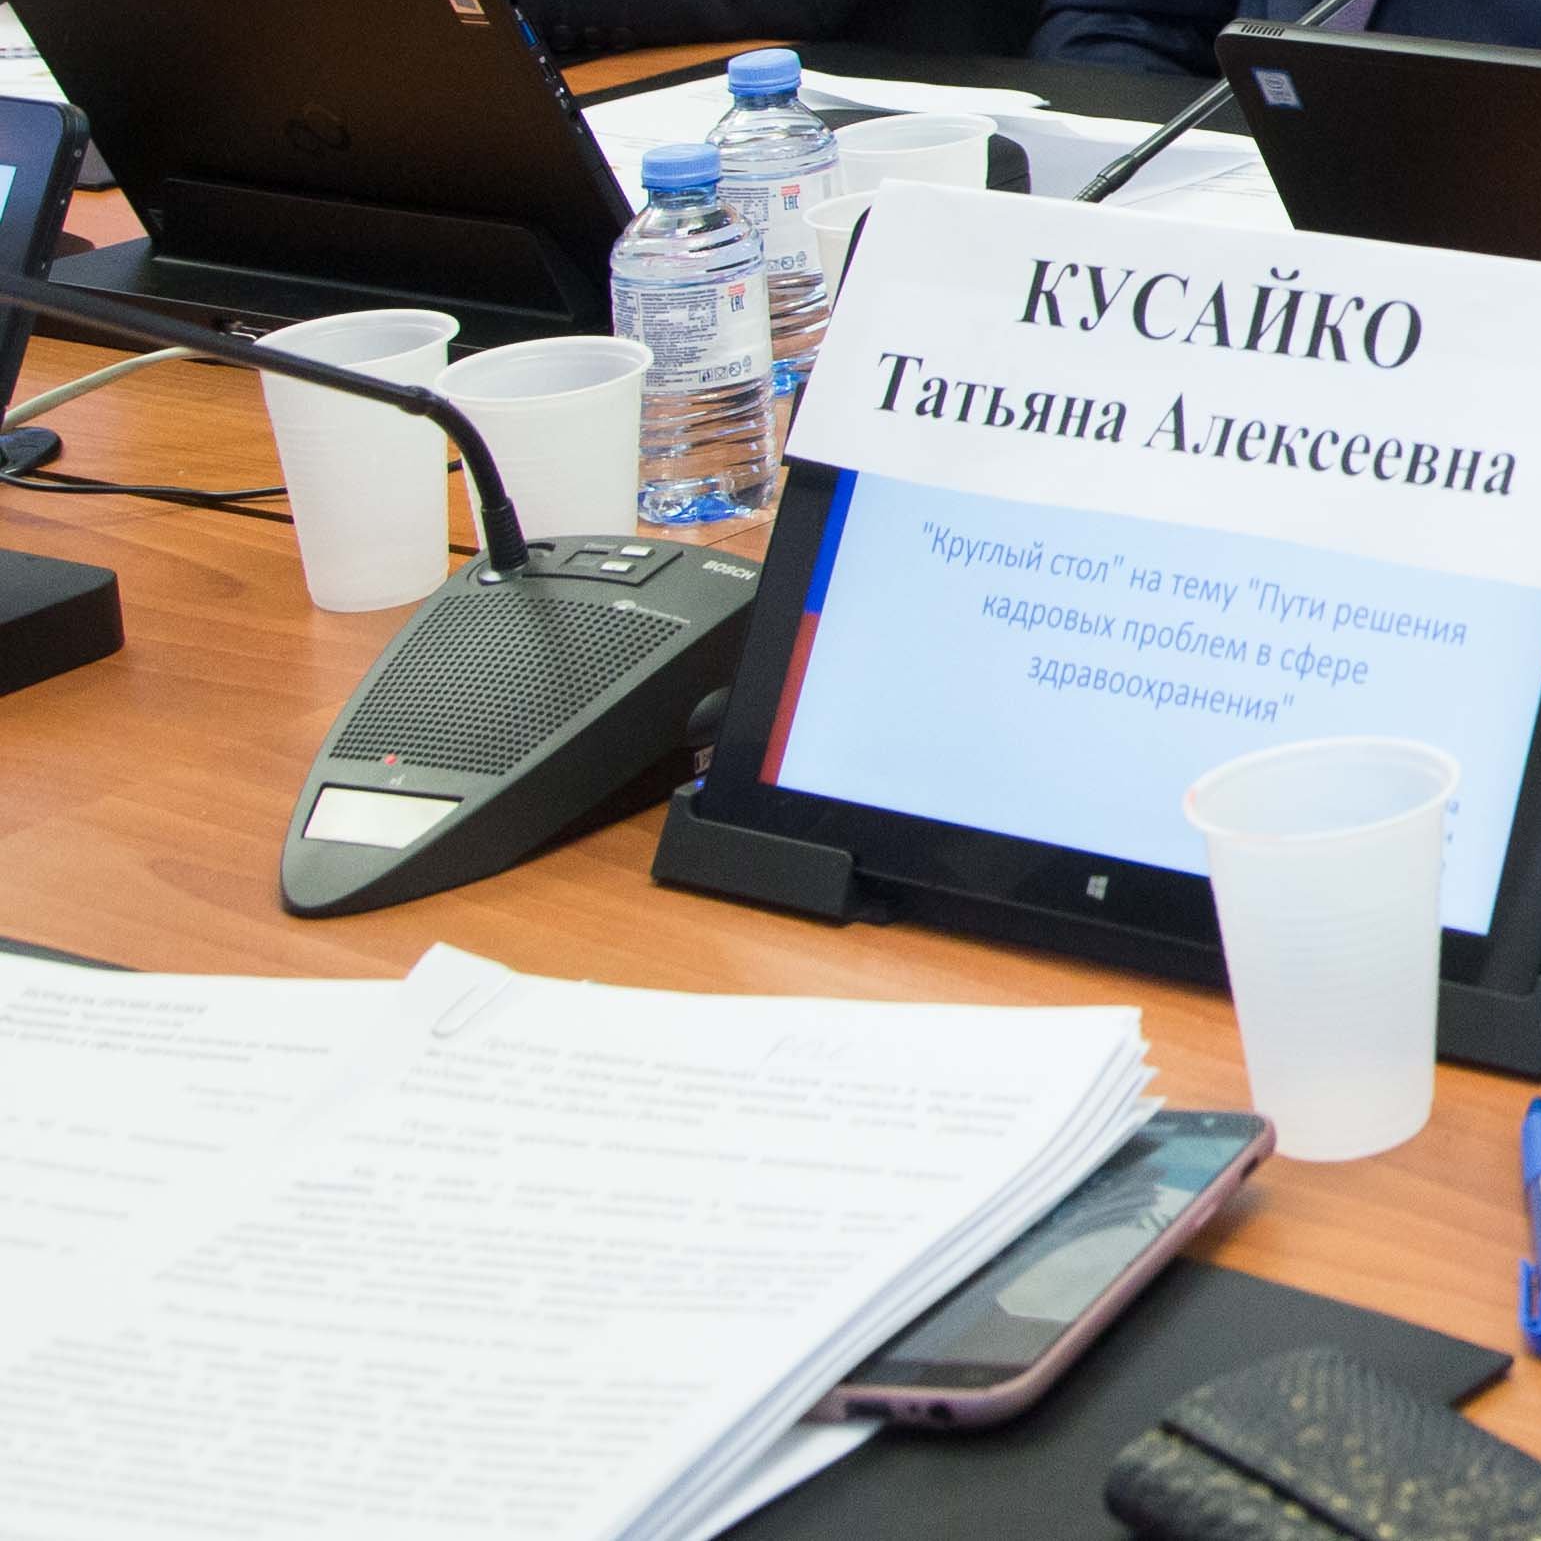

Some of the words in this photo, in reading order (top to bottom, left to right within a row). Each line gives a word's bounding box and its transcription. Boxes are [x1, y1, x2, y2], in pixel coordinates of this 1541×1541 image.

[1018, 258, 1423, 370] КУСАЙКО
[873, 352, 1126, 445] Татьяна
[1145, 393, 1517, 497] Алексеевна
[703, 560, 756, 580] BOSCH
[922, 521, 1043, 571] "Круглый
[1049, 552, 1124, 583] стол"
[1129, 565, 1162, 592] на
[1171, 573, 1239, 611] тему
[1248, 577, 1326, 622] "Пути
[1333, 601, 1468, 646] решения
[981, 592, 1114, 639] кадровых
[1122, 617, 1247, 664] проблем
[1255, 640, 1272, 666] в
[1279, 642, 1369, 687] сфере
[1026, 654, 1295, 723] здравоохранения"
